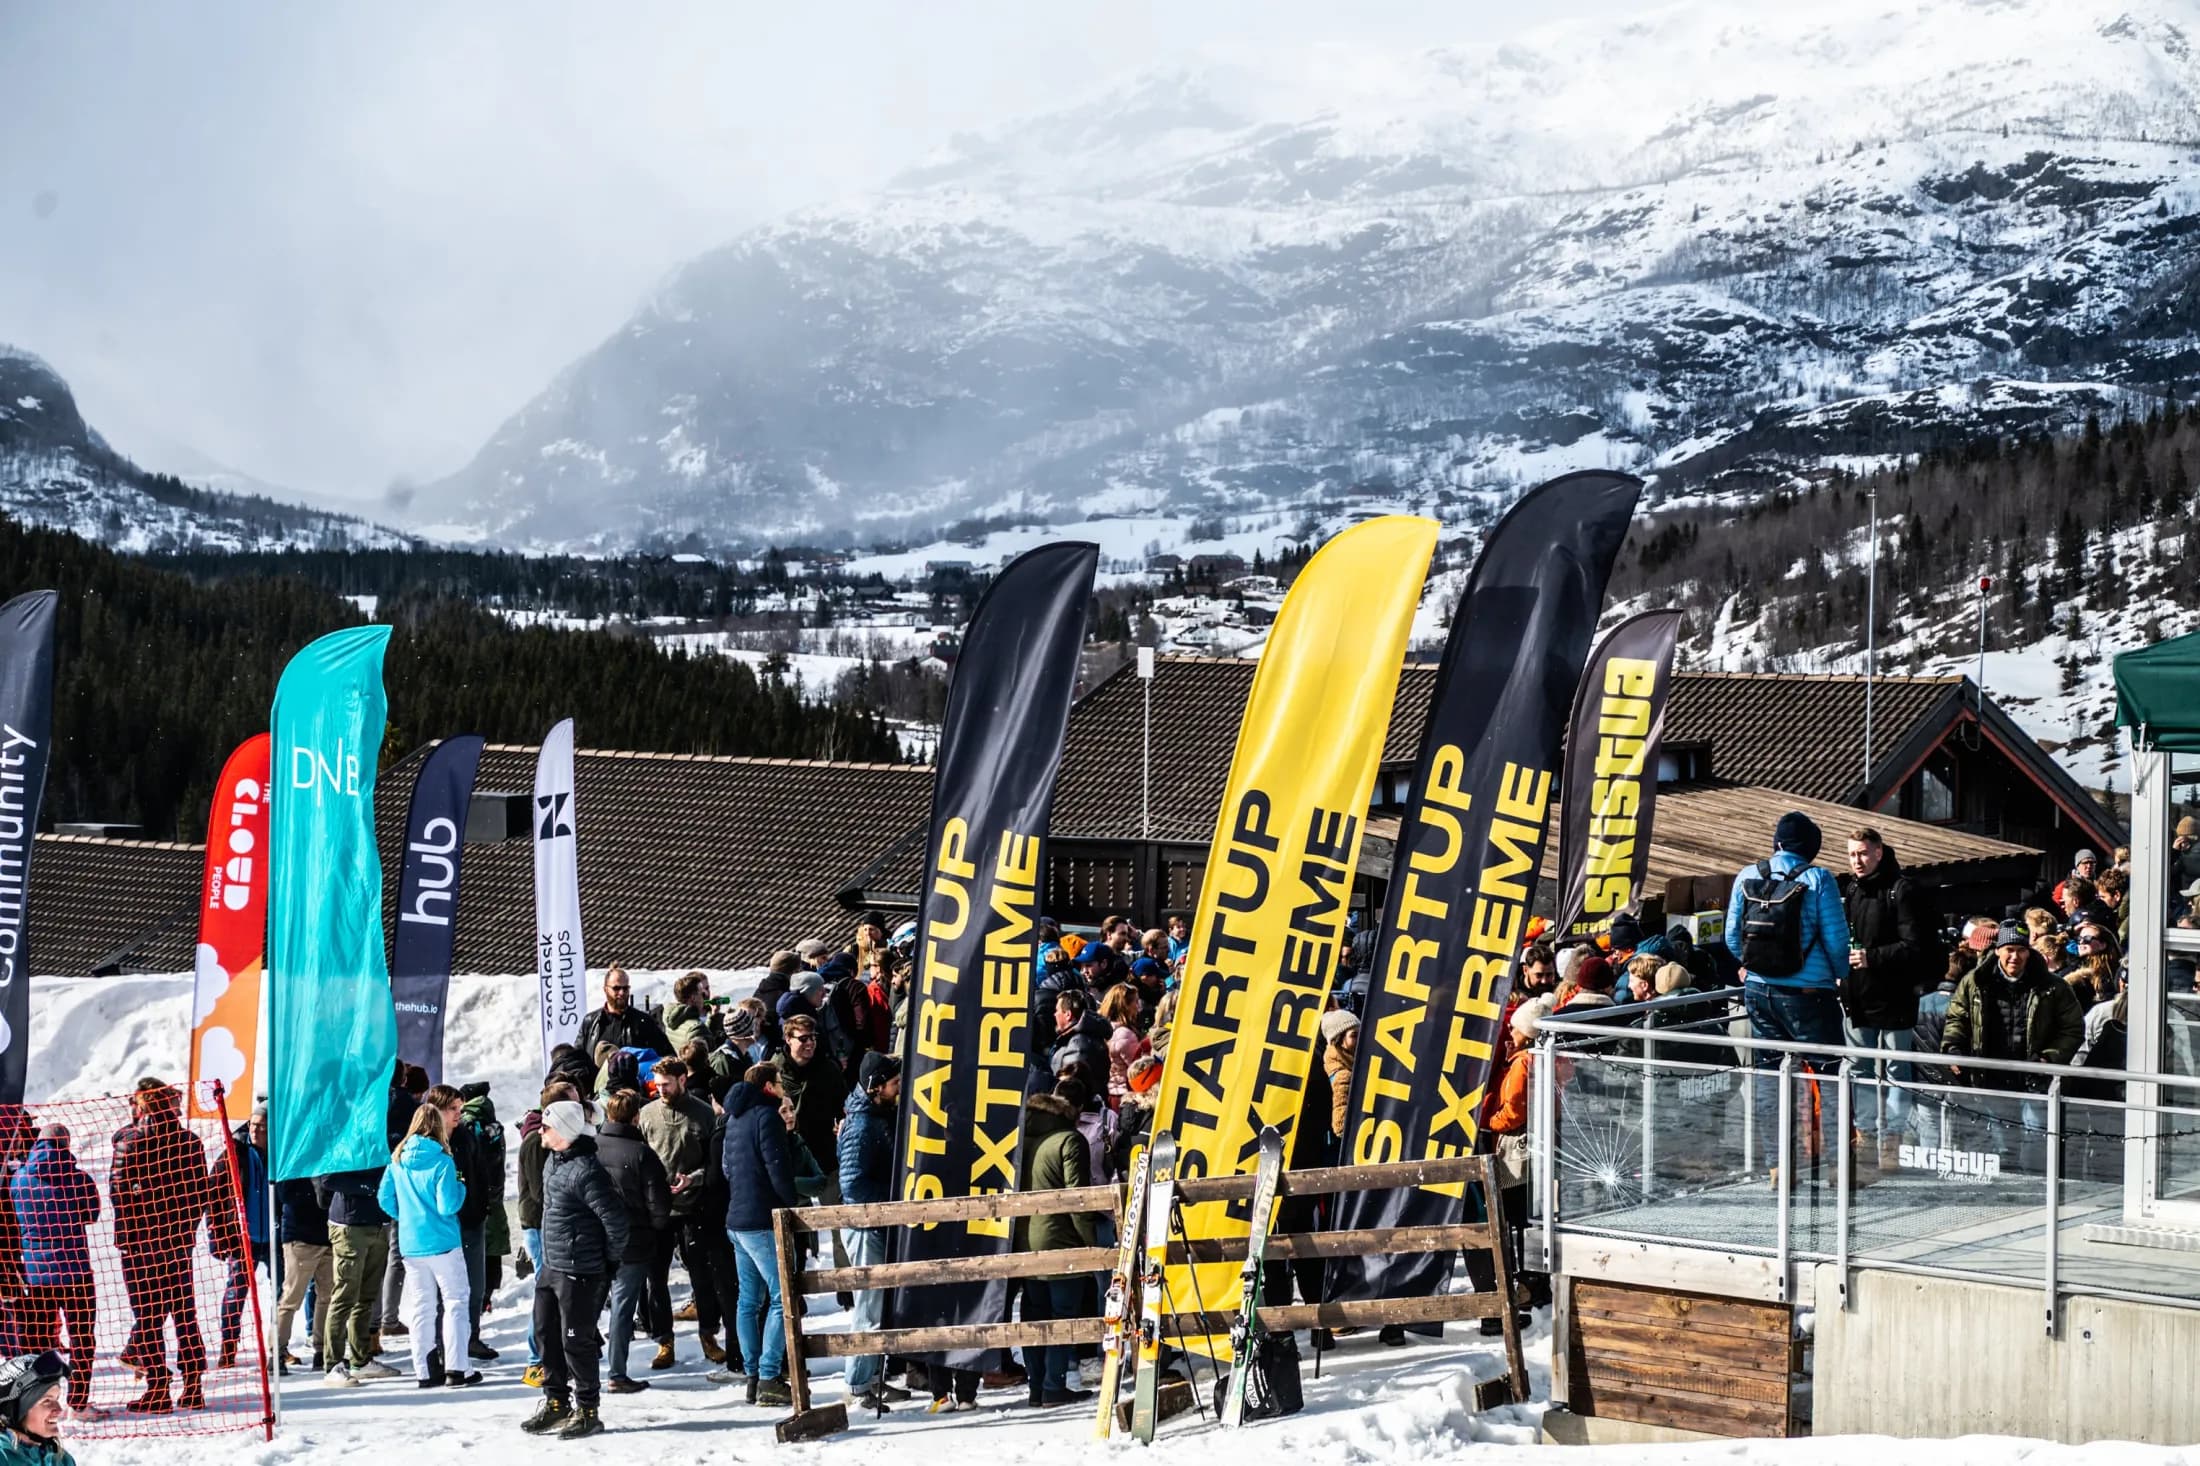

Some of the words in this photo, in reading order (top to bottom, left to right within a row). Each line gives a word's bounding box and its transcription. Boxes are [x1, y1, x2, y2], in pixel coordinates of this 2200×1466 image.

[292, 737, 360, 808] DNB
[209, 866, 223, 910] PEOPLE
[223, 778, 260, 911] CLOUD
[401, 817, 457, 926] hub
[395, 1002, 439, 1015] thehub.io
[557, 929, 578, 1026] Startups
[1353, 744, 1472, 1167] STARTUP
[904, 816, 976, 1231] STARTUP
[967, 829, 1040, 1239] EXTREME
